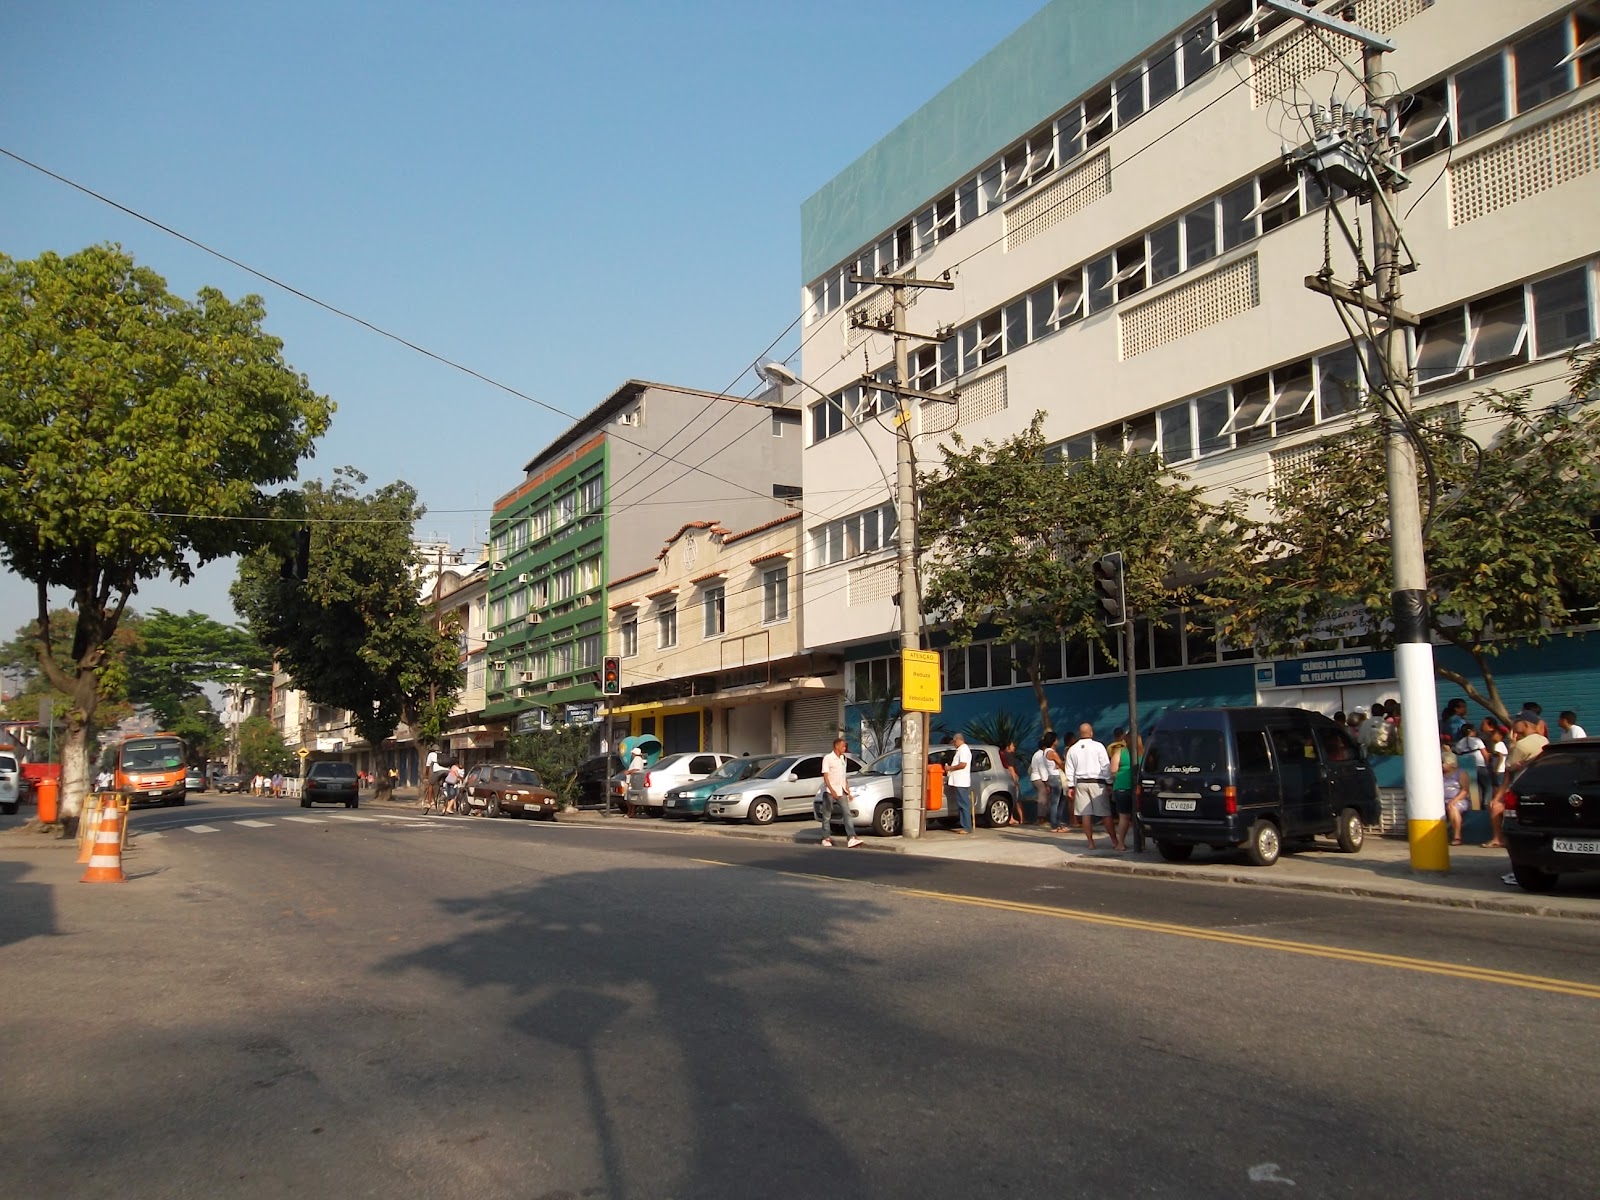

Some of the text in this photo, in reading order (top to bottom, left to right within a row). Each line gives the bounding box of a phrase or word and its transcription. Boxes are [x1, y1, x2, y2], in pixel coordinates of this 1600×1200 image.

[910, 652, 934, 660] ATENÇÃO
[1302, 657, 1363, 671] CLÍNICA DA FAMÍLIA
[1335, 669, 1366, 680] CARDOSO
